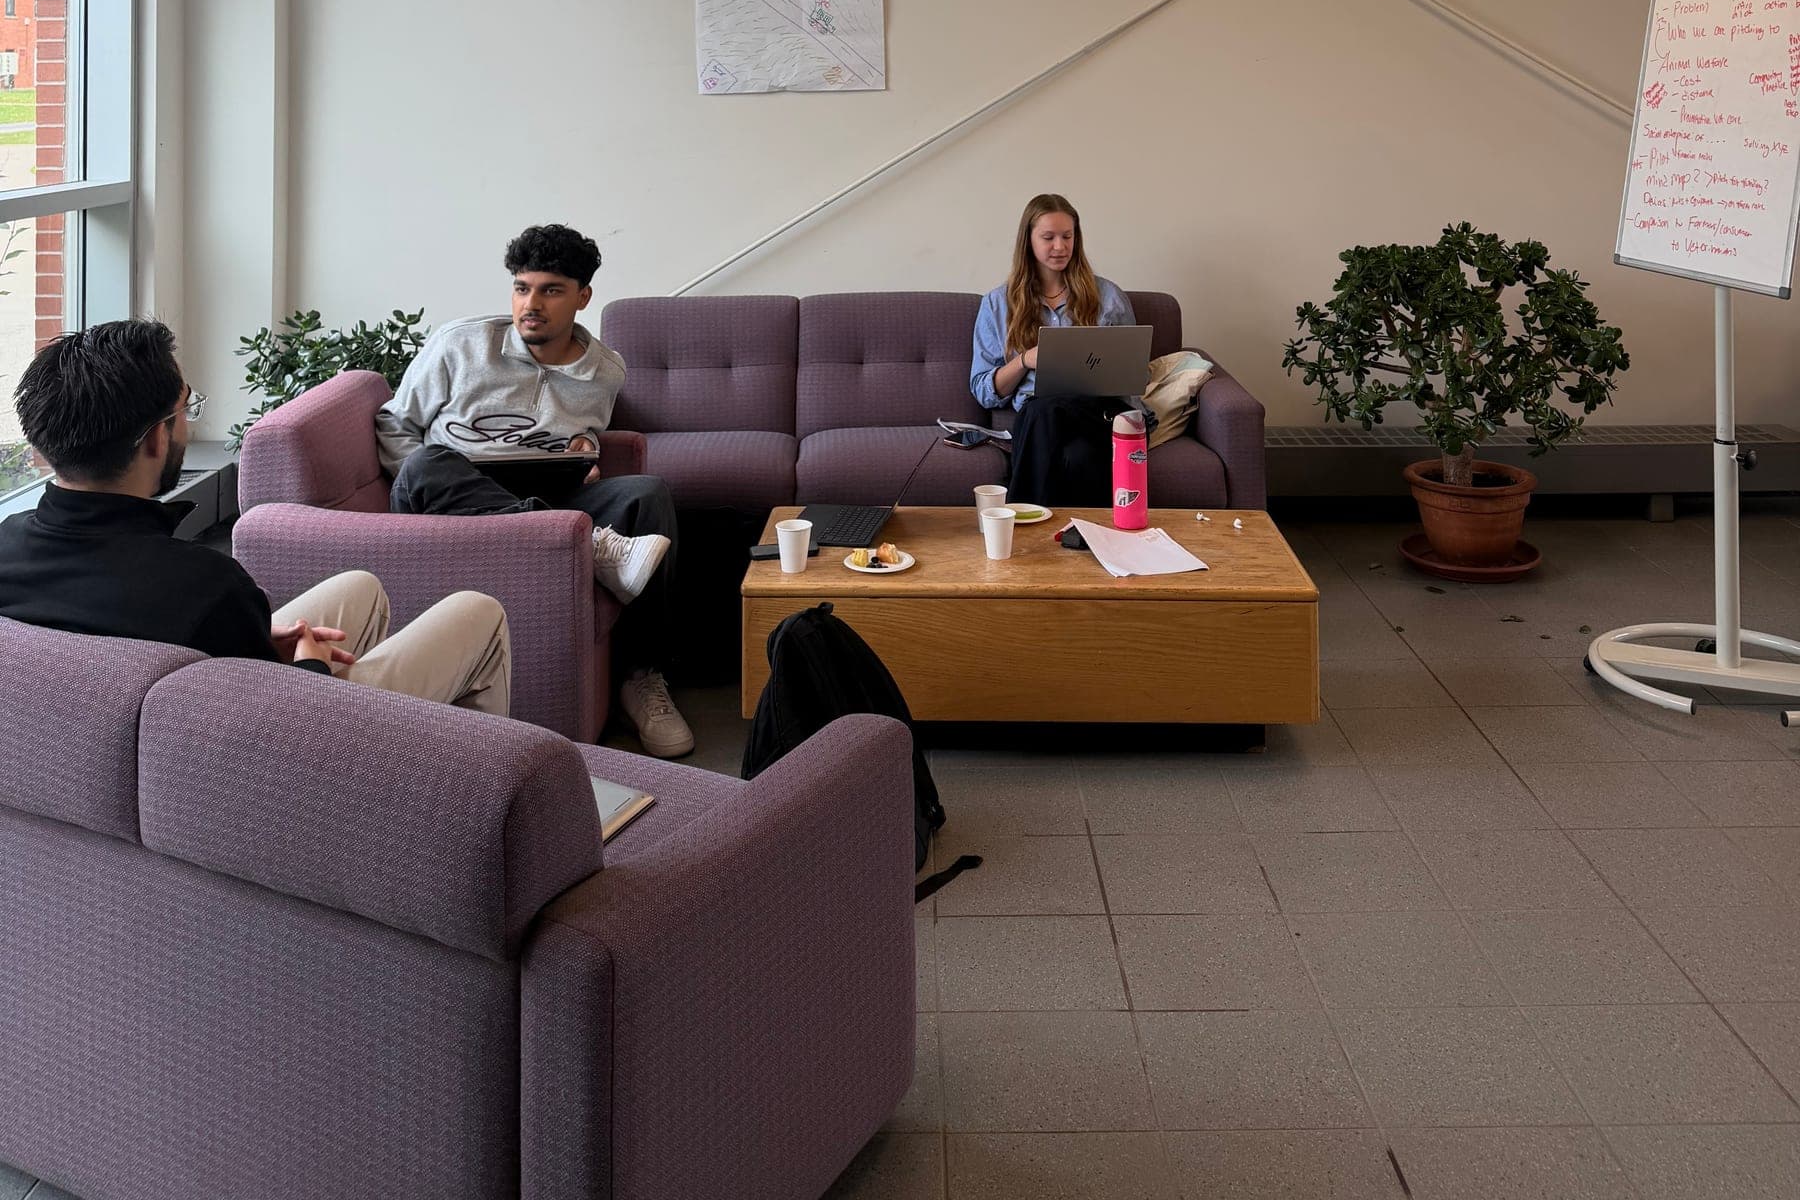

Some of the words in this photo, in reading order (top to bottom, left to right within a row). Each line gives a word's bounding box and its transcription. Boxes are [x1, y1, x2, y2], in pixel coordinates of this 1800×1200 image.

[1673, 0, 1710, 17] Problem
[1693, 26, 1707, 38] we
[1730, 24, 1765, 42] pitching
[1769, 24, 1780, 35] to
[1658, 56, 1691, 74] Animal
[1671, 240, 1680, 251] to
[1085, 352, 1101, 371] hp
[446, 414, 571, 454] Golde
